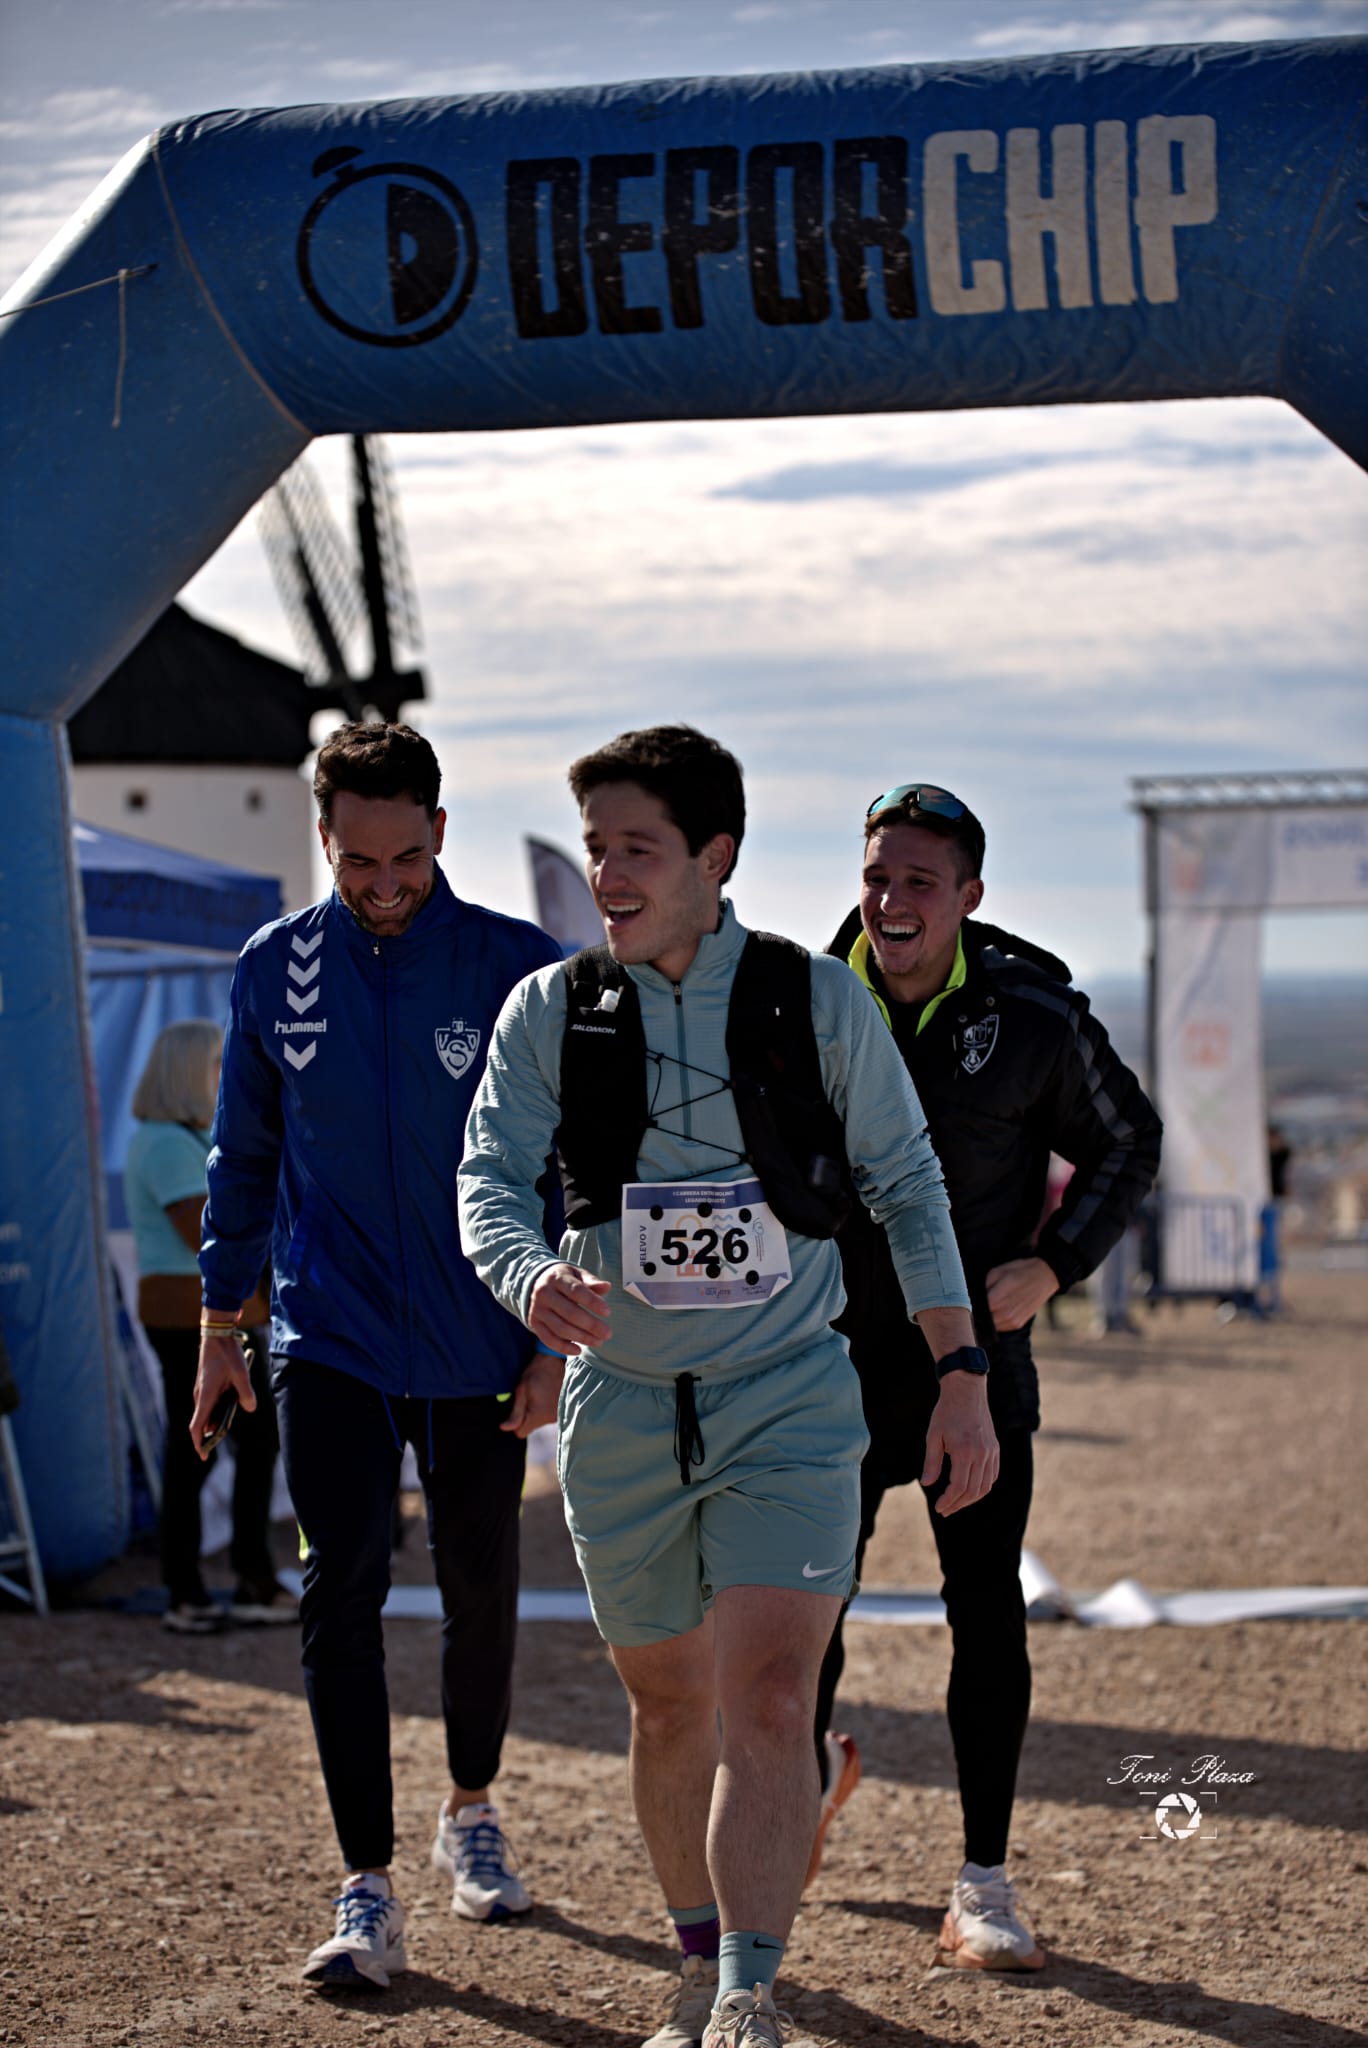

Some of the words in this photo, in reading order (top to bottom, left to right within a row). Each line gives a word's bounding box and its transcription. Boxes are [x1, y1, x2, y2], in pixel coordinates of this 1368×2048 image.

[274, 1018, 327, 1034] hummel
[570, 1023, 617, 1035] SALOMON
[660, 1228, 749, 1265] 526
